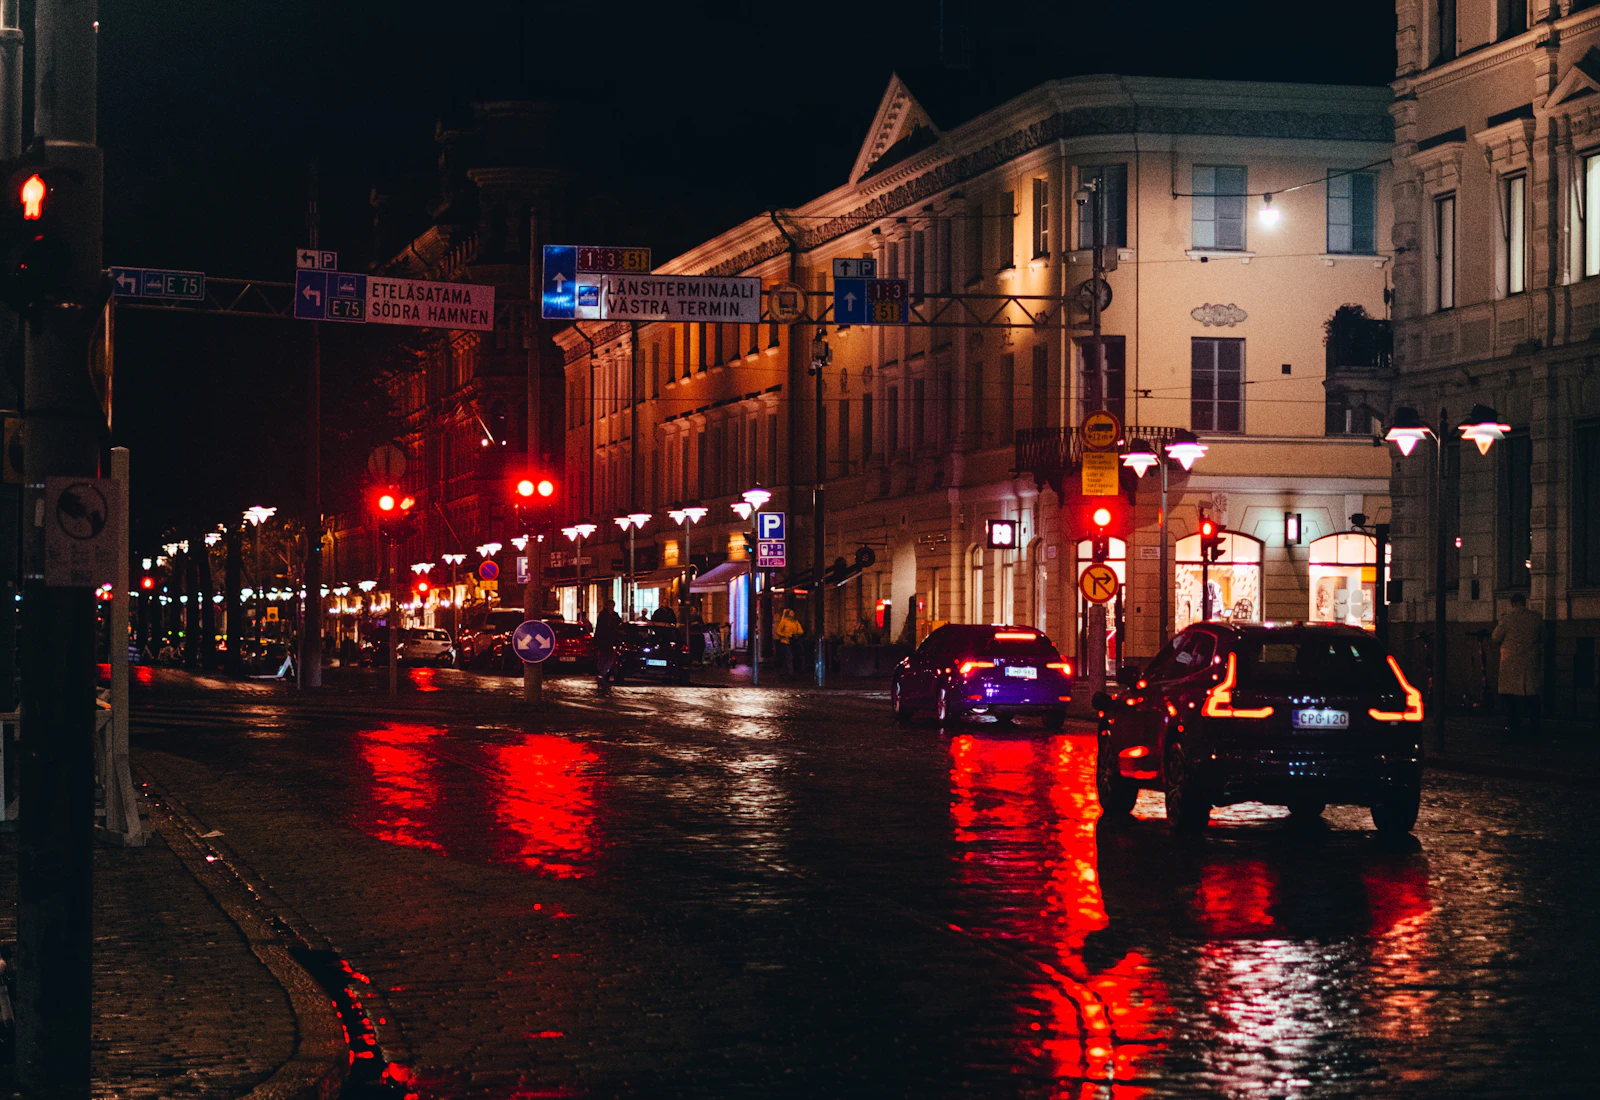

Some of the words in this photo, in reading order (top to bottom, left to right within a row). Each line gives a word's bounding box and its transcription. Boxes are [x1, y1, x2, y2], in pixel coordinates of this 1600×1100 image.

[323, 253, 333, 268] P
[586, 251, 593, 267] 1
[607, 252, 615, 268] 3
[628, 253, 643, 268] 51
[861, 261, 872, 276] P
[167, 277, 176, 293] E
[181, 277, 198, 294] 75
[372, 282, 472, 305] ETELÄSATAMA
[607, 278, 754, 299] LÄNSITERMINAALI
[875, 284, 881, 299] 1
[892, 284, 901, 299] 3
[332, 300, 341, 315] E
[344, 301, 360, 317] 75
[372, 300, 421, 320] SÖDRA
[428, 306, 489, 325] HAMNEN
[608, 297, 671, 315] VÄSTRA
[678, 300, 744, 317] TERMIN.
[880, 305, 895, 320] 51
[763, 514, 781, 538] P
[1300, 713, 1347, 725] CPG-120
